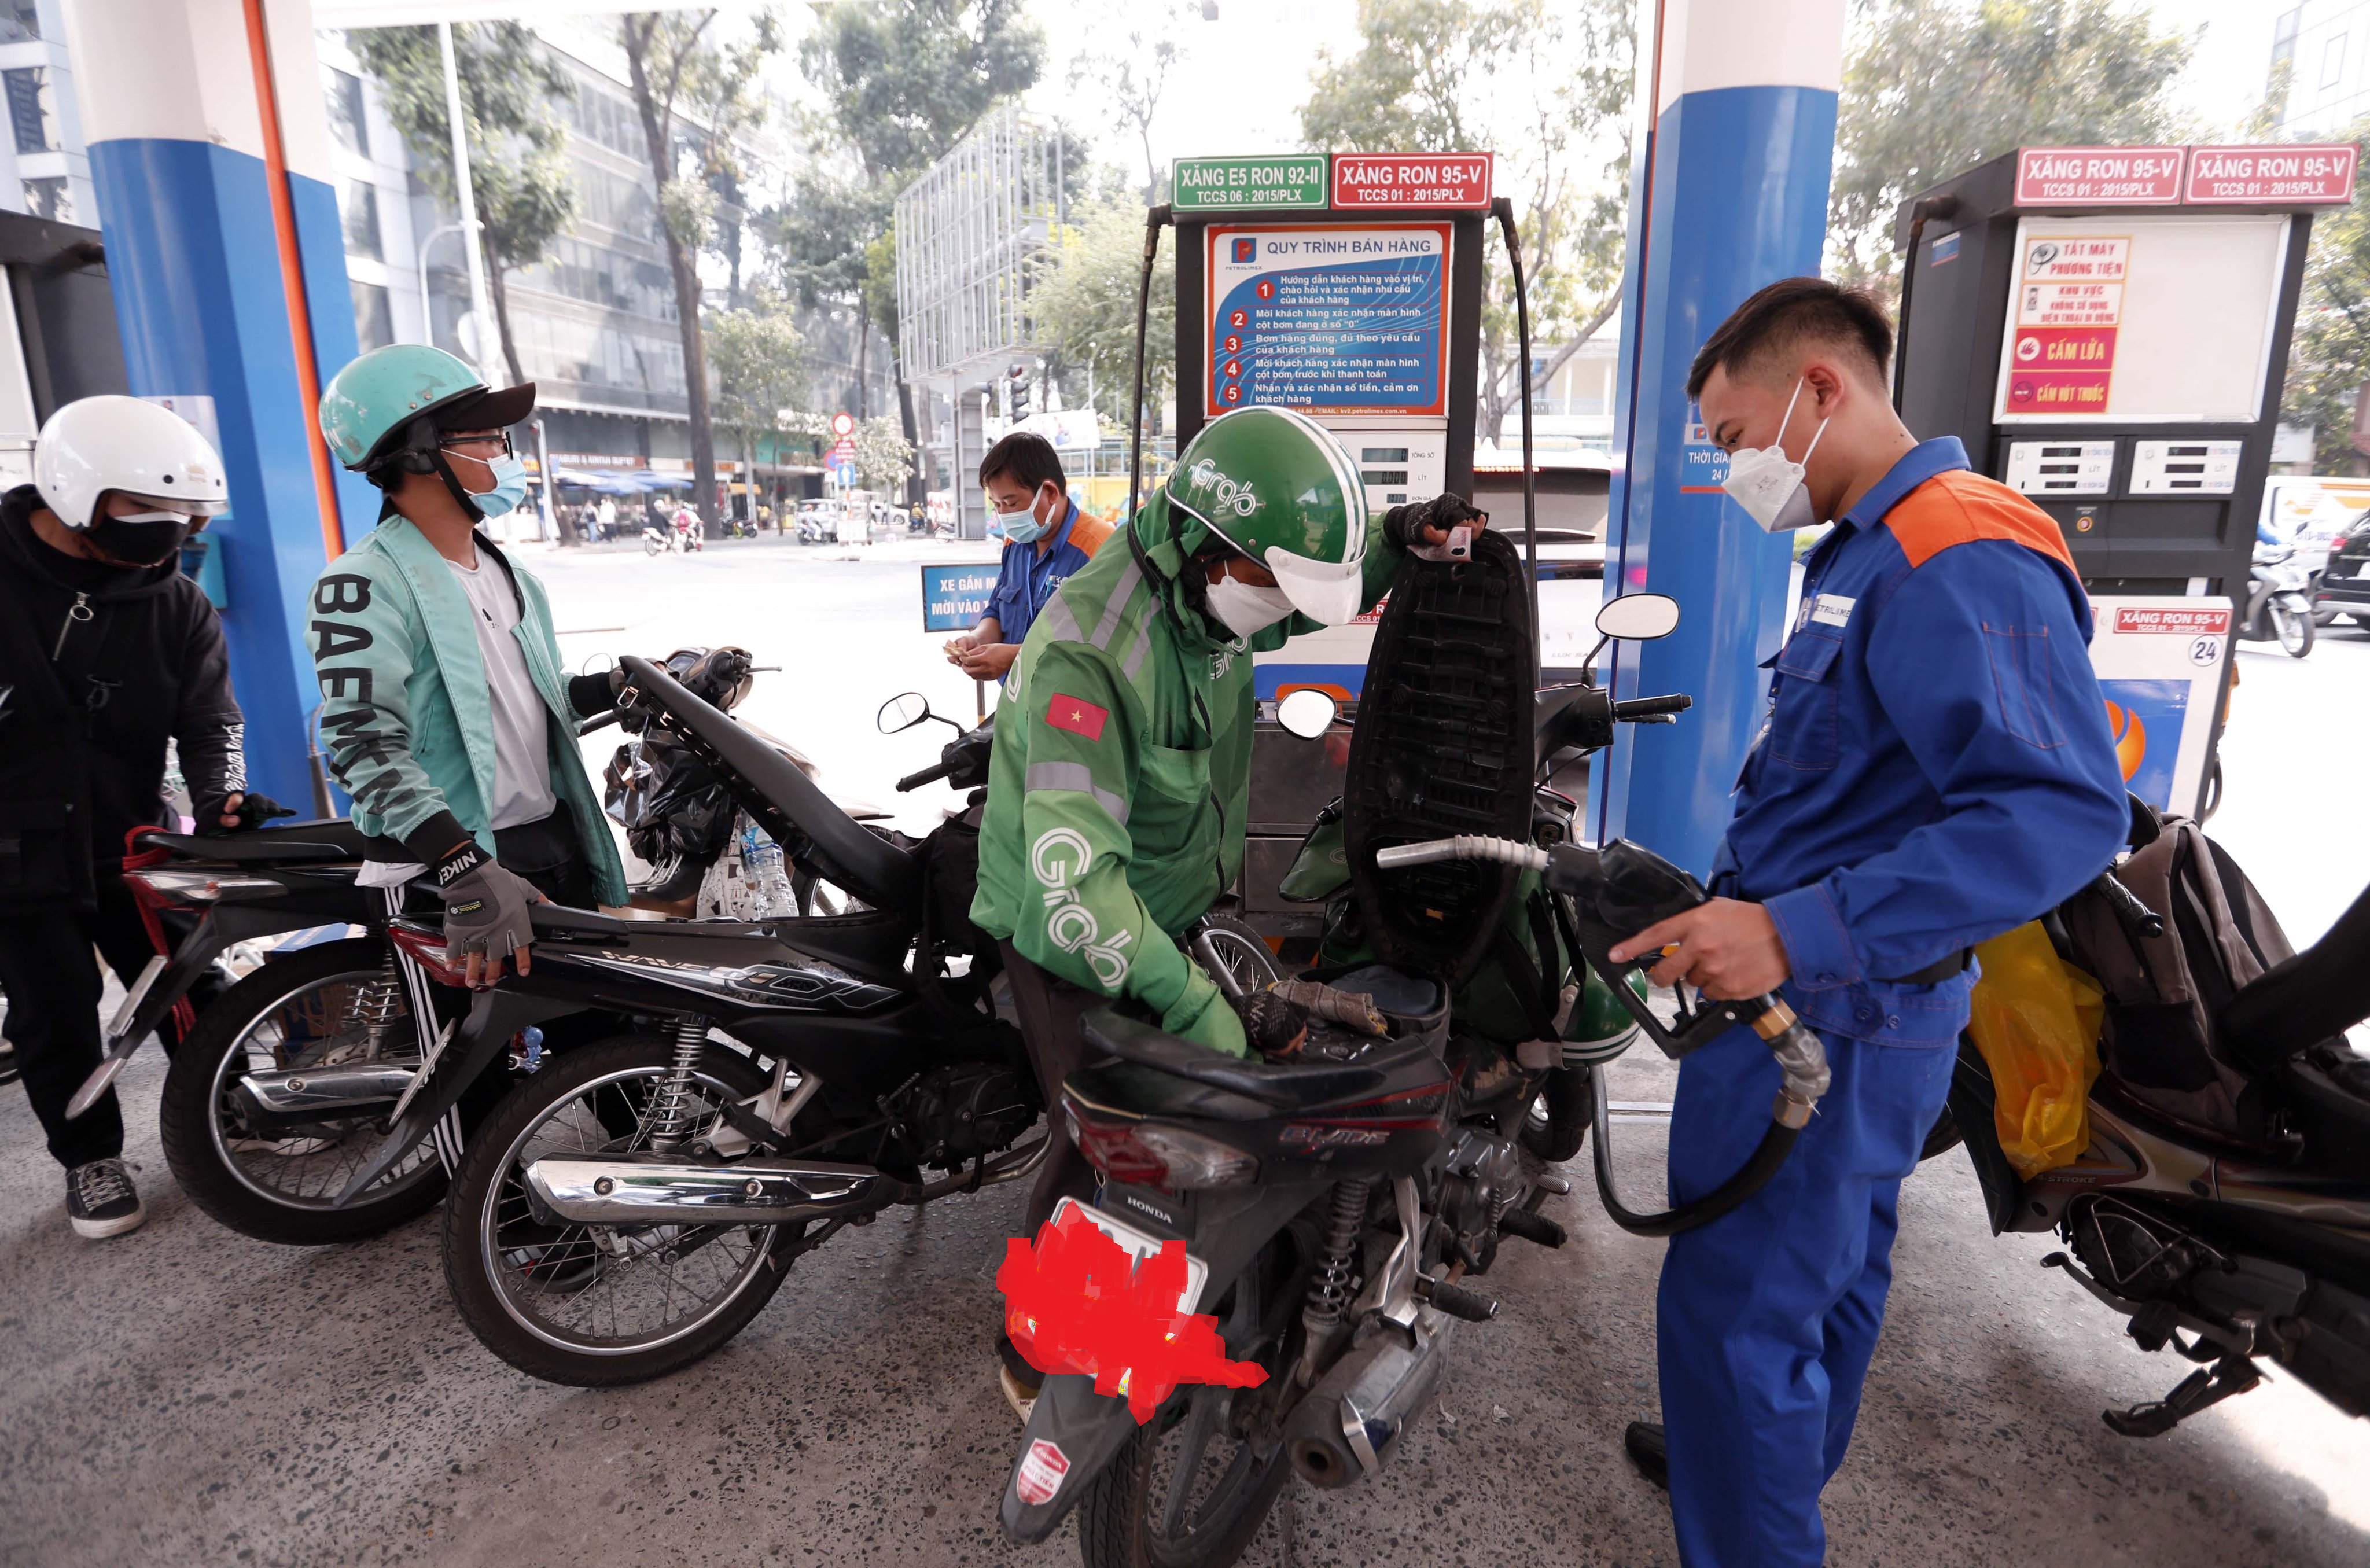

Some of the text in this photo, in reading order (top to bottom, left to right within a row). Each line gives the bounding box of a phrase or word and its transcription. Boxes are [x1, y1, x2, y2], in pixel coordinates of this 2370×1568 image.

[1342, 161, 1481, 185] XĂNG RON 95-V
[2027, 155, 2176, 179] XĂNG RON 95-V
[2197, 154, 2347, 179] XĂNG RON 95-V
[1181, 164, 1319, 186] XĂNG E5 RON 92-II
[1357, 189, 1388, 201] TCCS
[1391, 189, 1404, 201] 01
[1413, 188, 1464, 201] 2015/PLX
[2042, 183, 2074, 197] TCCS
[2077, 183, 2092, 196] 01
[2100, 182, 2155, 197] 2015/PLX
[2212, 183, 2244, 196] TCCS
[2247, 182, 2261, 195] 01
[2270, 181, 2325, 195] 2015/PLX
[1197, 190, 1227, 203] TCCS
[1230, 190, 1242, 202] 06
[1252, 189, 1301, 202] 2015/PLX
[1267, 238, 1431, 254] QUY TRÌNH BÁN HÀNG
[1312, 274, 1328, 284] dẫn
[1331, 274, 1357, 284] khách
[1360, 274, 1382, 284] hàng
[1384, 274, 1400, 283] vào
[1261, 284, 1268, 297] 1
[1280, 286, 1302, 294] chào
[1321, 285, 1330, 293] và
[1333, 285, 1349, 293] xác
[1351, 285, 1373, 295] nhận
[1375, 285, 1392, 293] nhu
[1394, 284, 1411, 293] cầu
[1280, 296, 1349, 305] của khách hàng
[1234, 313, 1243, 326] 2
[1256, 308, 1421, 318] Mời khách hàng xác nhận màn hình
[1256, 322, 1271, 330] cột
[1296, 321, 1319, 330] đang
[1330, 319, 1342, 328] số
[1228, 338, 1237, 351] 3
[1256, 334, 1278, 343] Bơm
[1281, 334, 1306, 344] hàng
[1341, 333, 1353, 342] đủ
[1356, 334, 1378, 342] theo
[1381, 334, 1399, 344] yêu
[1401, 332, 1420, 342] cầu
[1256, 345, 1335, 355] của khách hàng
[2047, 337, 2106, 361] CẤM LỬA
[1228, 362, 1237, 376] 4
[1305, 359, 1328, 368] hàng
[1331, 359, 1348, 367] xác
[1350, 359, 1373, 368] nhận
[1376, 358, 1396, 367] màn
[1399, 358, 1419, 367] hình
[1256, 371, 1270, 380] cột
[1295, 370, 1319, 378] trước
[1367, 370, 1387, 378] toán
[1228, 387, 1237, 400] 5
[1256, 384, 1280, 393] Nhận
[1284, 384, 1294, 392] và
[1298, 384, 1315, 392] xác
[1318, 383, 1342, 393] nhận
[1345, 382, 1357, 392] số
[1383, 382, 1404, 392] cảm
[1407, 384, 1419, 392] ơn
[1287, 395, 1312, 404] hàng
[1688, 449, 1711, 464] THỜI
[1712, 469, 1722, 480] 24
[1194, 458, 1257, 517] Grab
[940, 574, 982, 592] XE GẮN
[932, 599, 980, 616] MỜI VÀO
[2162, 613, 2192, 624] RON
[2194, 614, 2226, 625] 95-V
[2194, 642, 2216, 660] 24
[440, 851, 477, 882] NIKE
[1032, 827, 1132, 987] Grab
[601, 950, 711, 973] WAVE
[1127, 1195, 1173, 1225] HONDA
